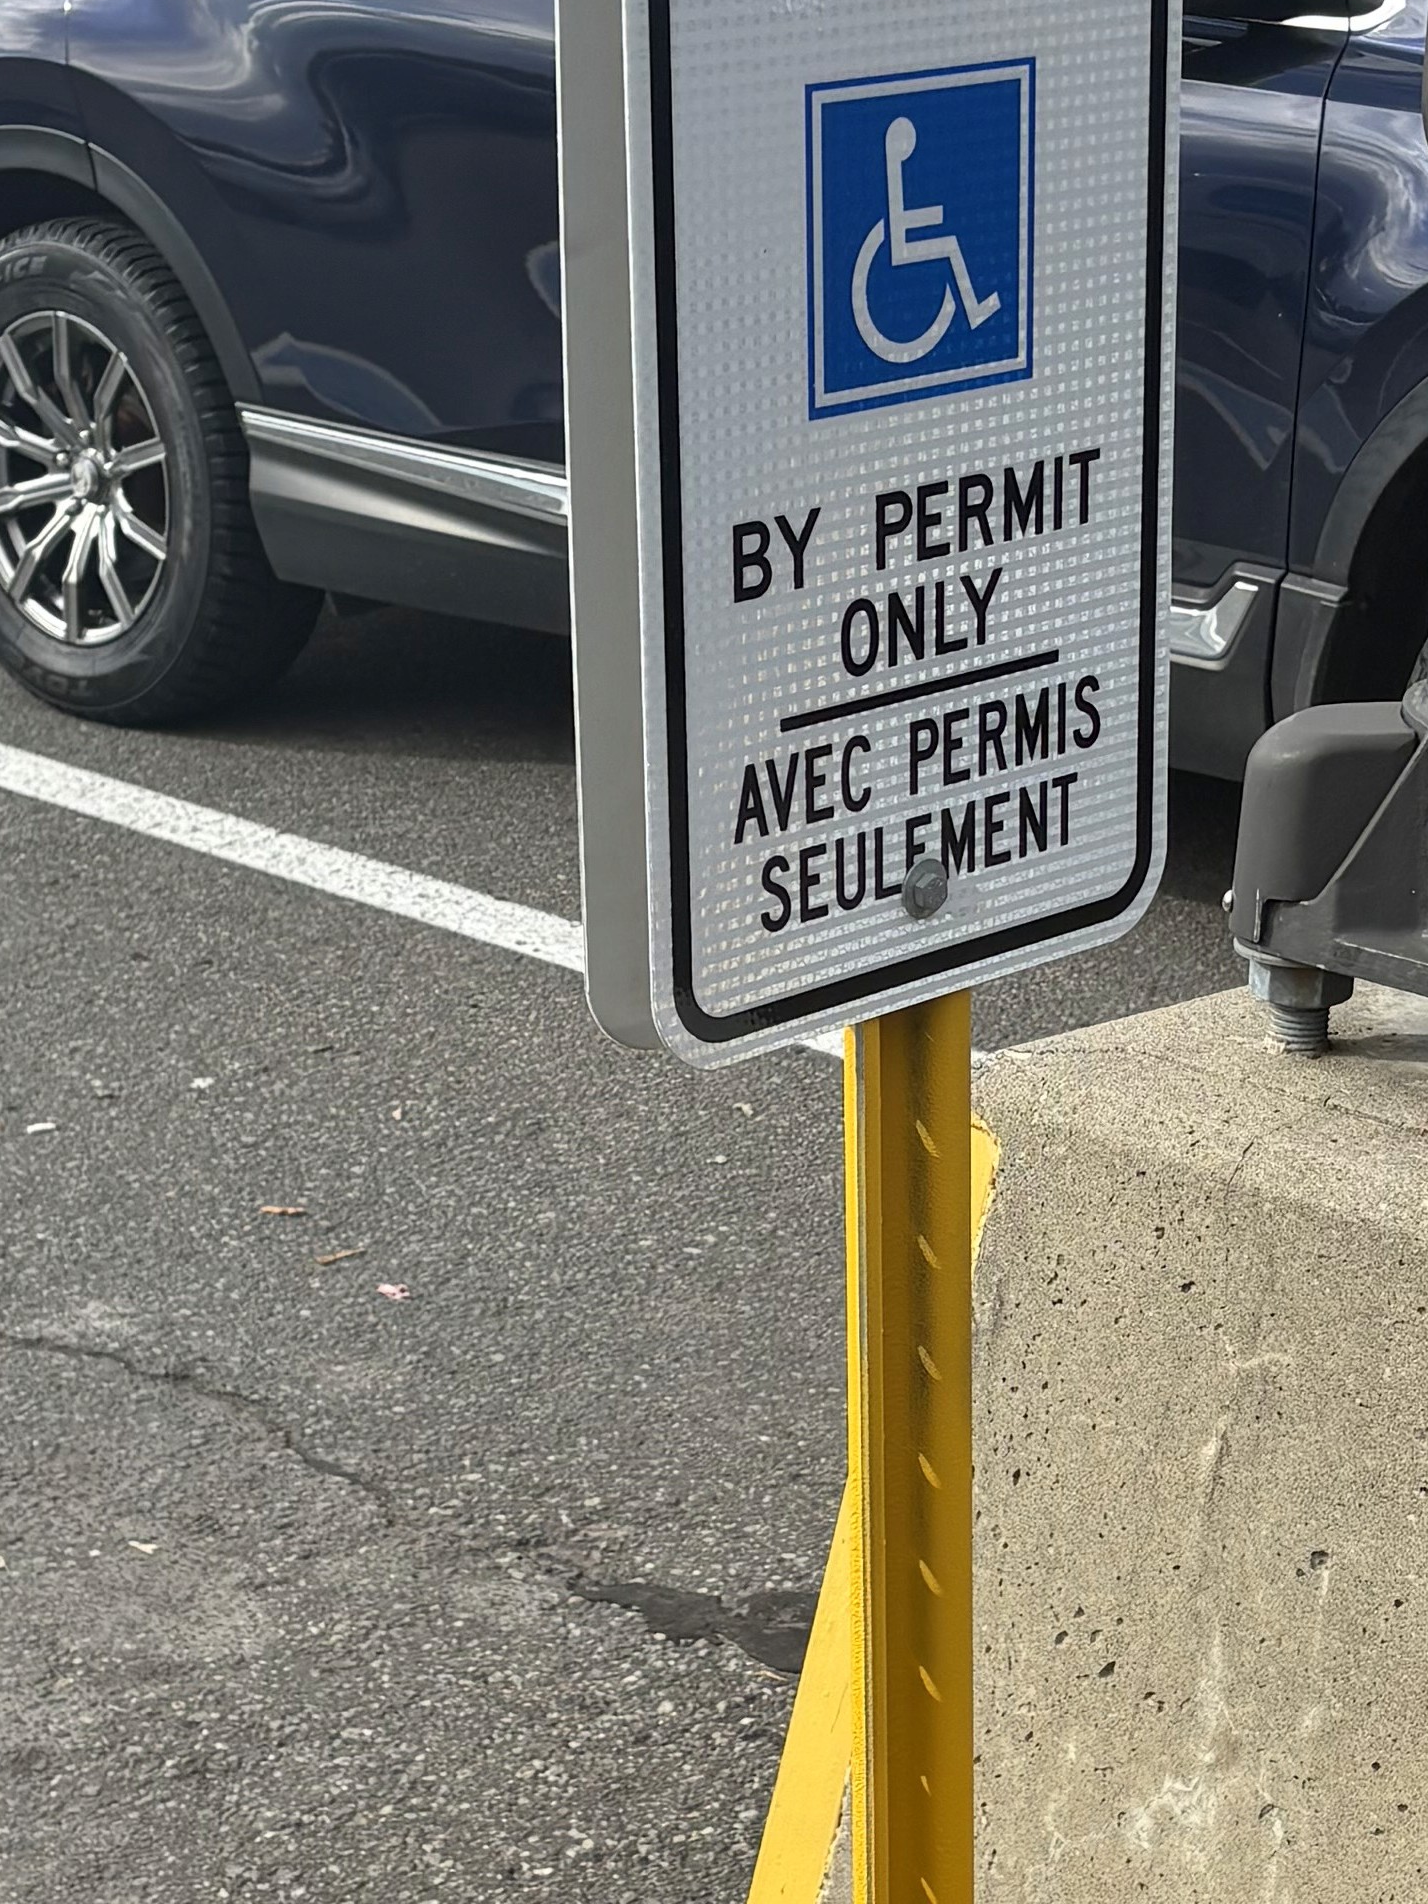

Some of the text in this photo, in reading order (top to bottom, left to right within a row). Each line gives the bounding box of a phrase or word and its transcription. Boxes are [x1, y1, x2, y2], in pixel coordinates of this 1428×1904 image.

[732, 448, 1101, 604] BY PERMIT
[840, 567, 1004, 678] ONLY
[734, 674, 1101, 845] AVEC PERMIS
[759, 772, 1079, 933] SEULEMENT
